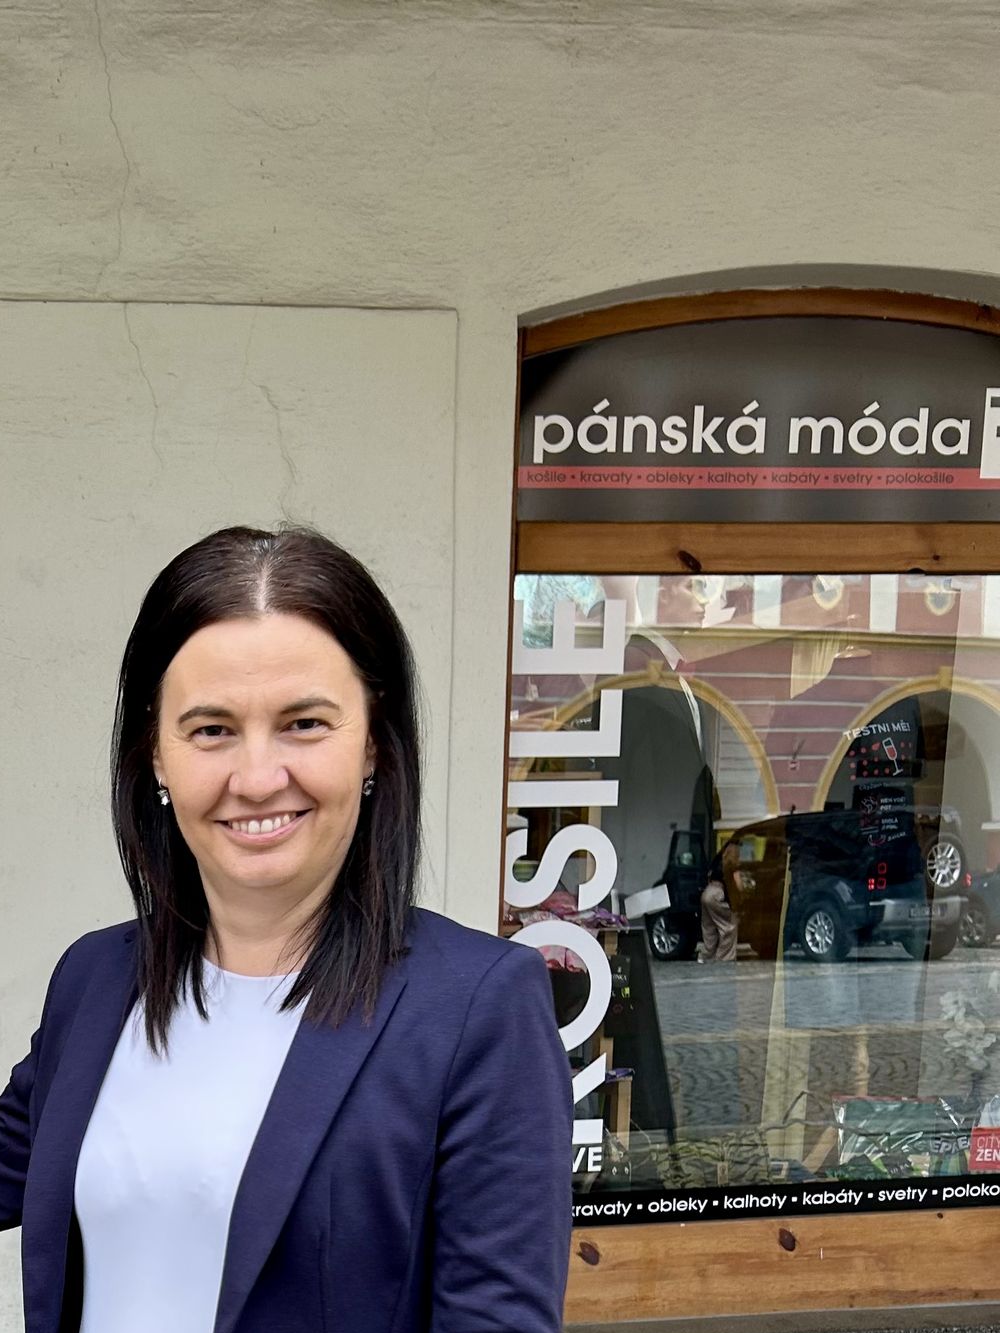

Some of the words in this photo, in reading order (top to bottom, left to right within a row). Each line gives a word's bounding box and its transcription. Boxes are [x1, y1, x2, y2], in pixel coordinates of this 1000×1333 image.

[533, 398, 767, 464] pánská
[788, 401, 971, 455] móda
[526, 470, 567, 483] košile
[579, 471, 633, 485] kravaty
[646, 471, 694, 485] obleky
[707, 471, 759, 485] kalhoty
[771, 471, 821, 485] kabáty
[832, 472, 873, 485] svetry
[885, 472, 955, 485] polokošile
[843, 722, 890, 740] TESTNI
[647, 1197, 708, 1214] obleky
[723, 1192, 787, 1210] kalhoty
[802, 1188, 863, 1206] kabáty
[877, 1186, 928, 1202] svetry
